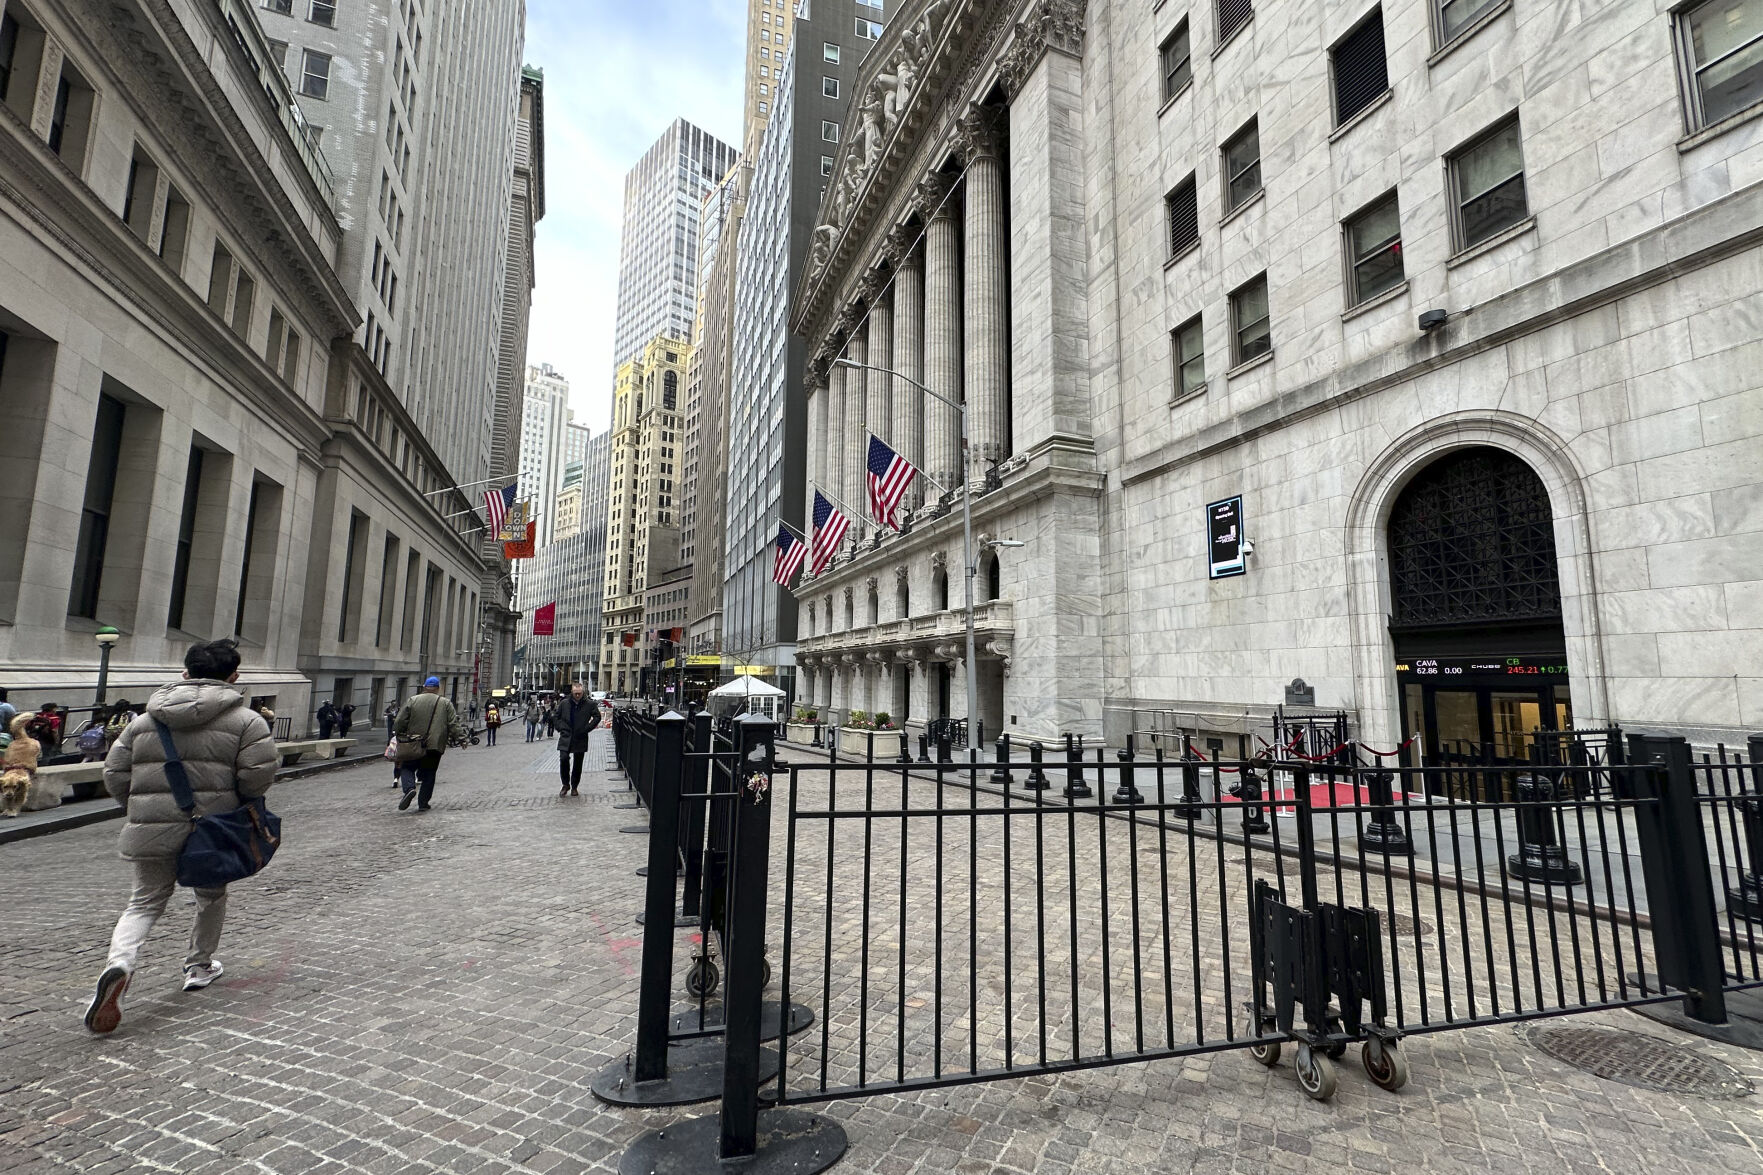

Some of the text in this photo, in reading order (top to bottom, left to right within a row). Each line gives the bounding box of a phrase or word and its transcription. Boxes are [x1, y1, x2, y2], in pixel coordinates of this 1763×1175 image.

[513, 511, 521, 538] DOWN
[1416, 667, 1438, 675] 62.86
[1507, 666, 1539, 674] 245.21
